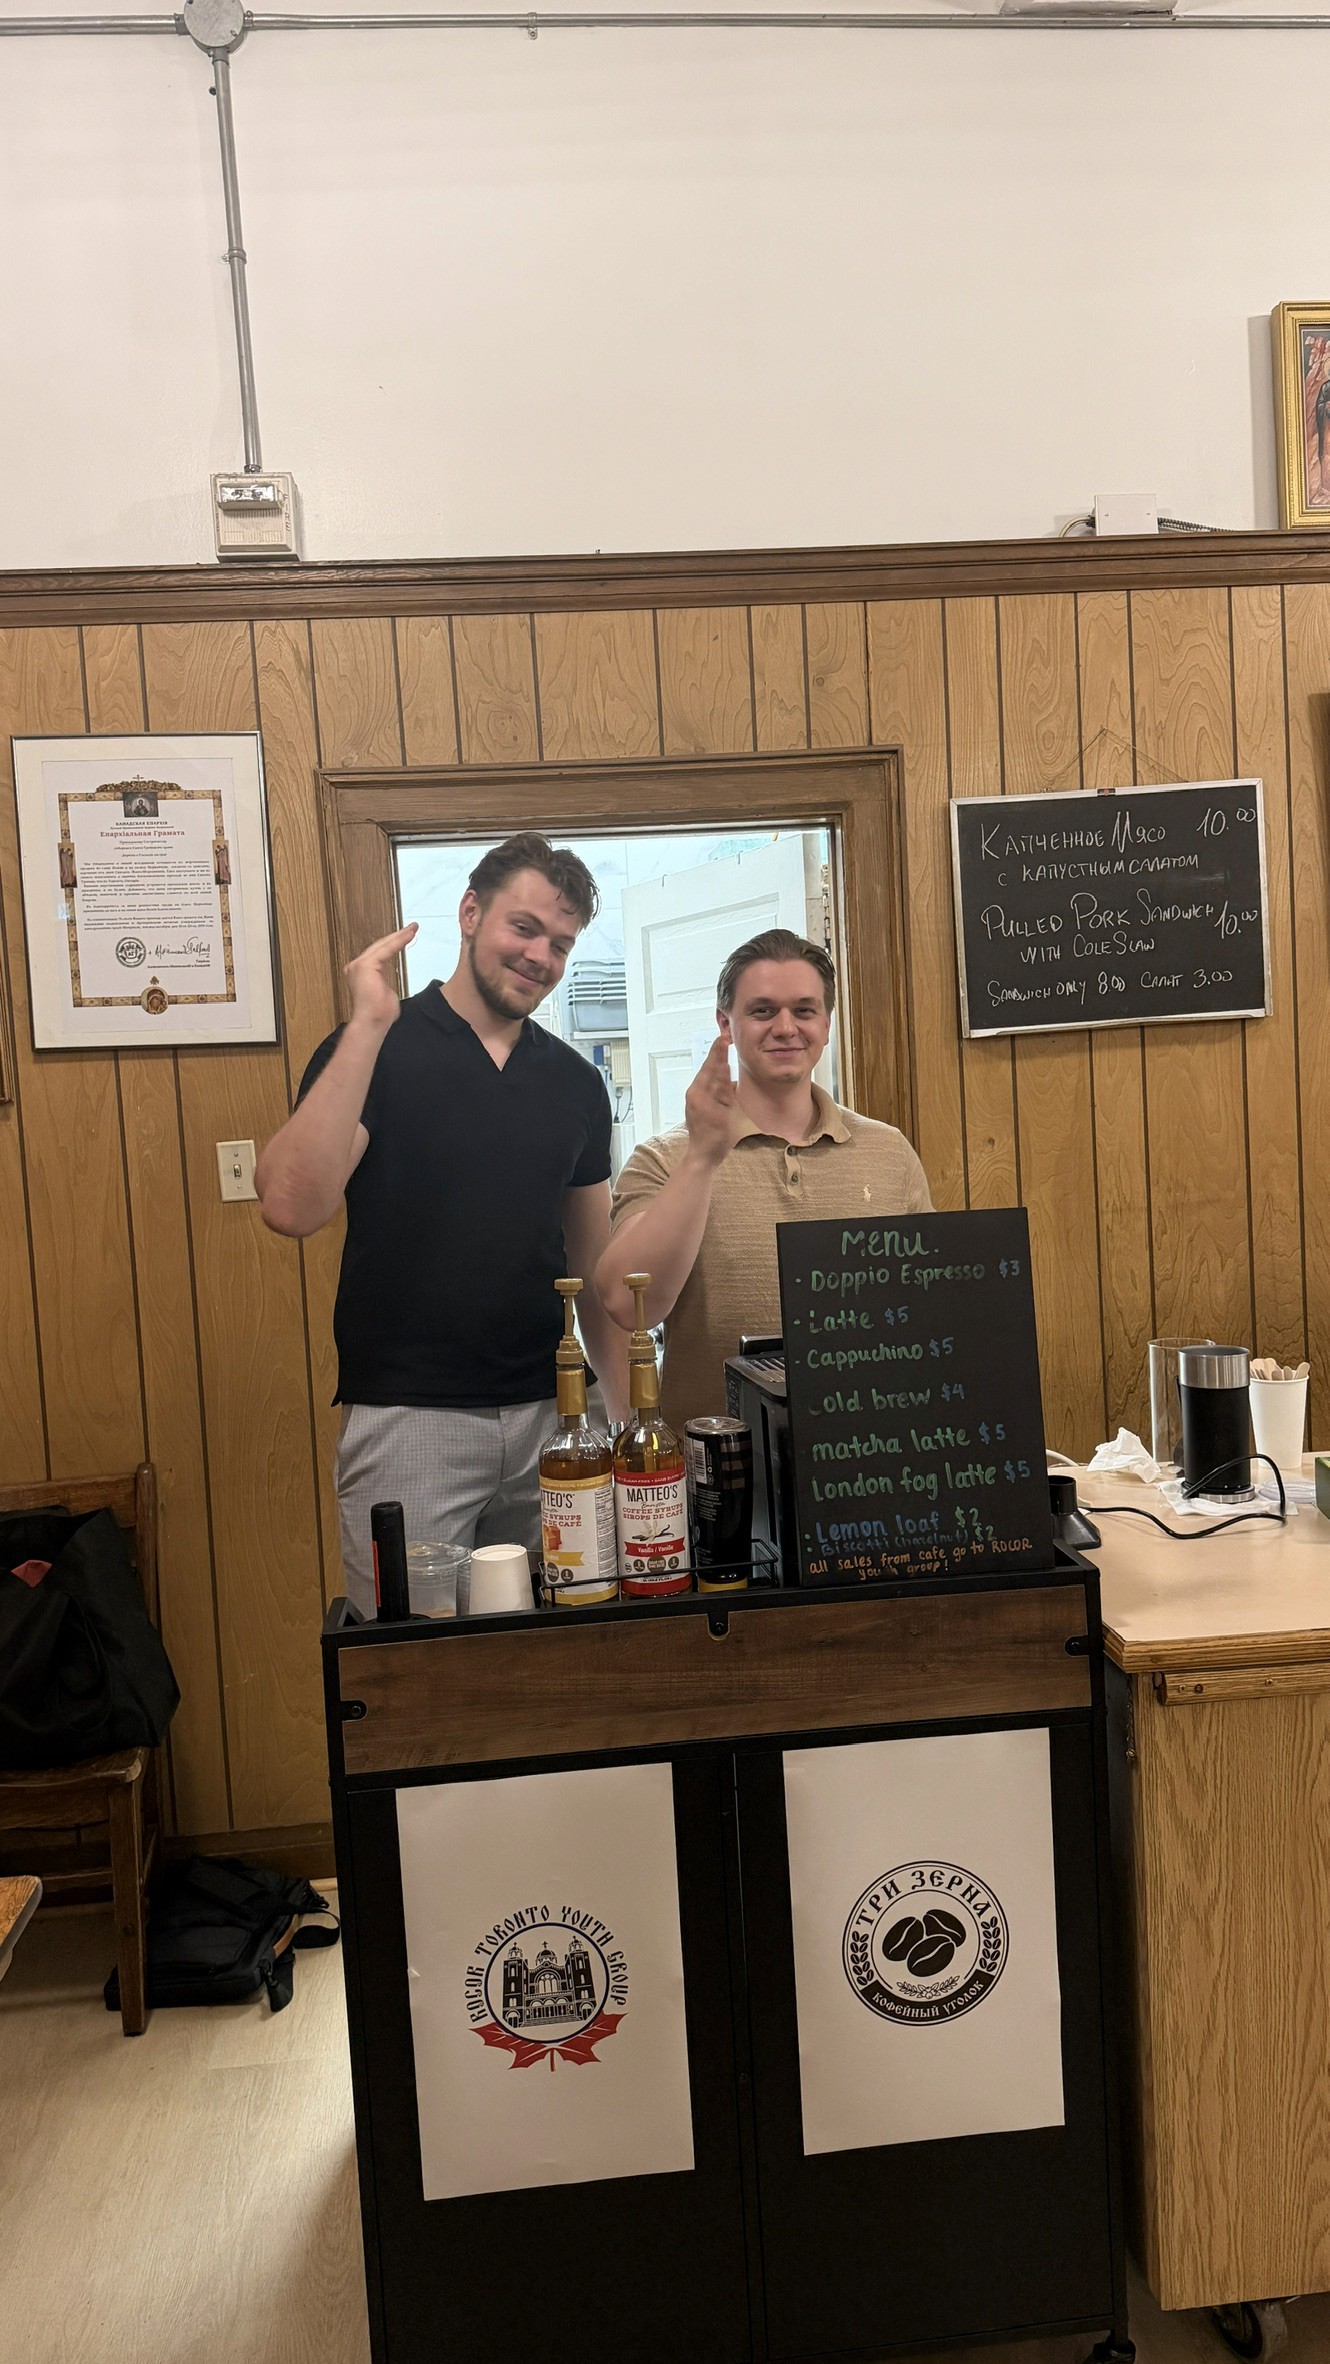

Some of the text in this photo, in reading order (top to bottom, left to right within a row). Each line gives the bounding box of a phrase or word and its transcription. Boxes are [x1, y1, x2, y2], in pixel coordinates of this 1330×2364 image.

[153, 830, 185, 838] Грамата
[1070, 892, 1130, 930] PORK
[1020, 944, 1061, 964] WITH
[1098, 971, 1125, 995] 8.00
[1193, 969, 1233, 988] 3.00
[811, 1258, 1020, 1298] Doppio Espresso $3
[809, 1306, 909, 1334] Latte $5
[806, 1336, 954, 1371] Cappuchino $5
[871, 1388, 931, 1410] brew
[941, 1382, 965, 1401] $4
[812, 1433, 903, 1462] matcha
[910, 1427, 971, 1452] latte
[626, 1484, 678, 1502] MATTEO'S
[900, 1466, 938, 1500] fog
[945, 1462, 997, 1489] latte
[654, 1503, 683, 1513] SYRUPS
[815, 1518, 888, 1544] Lemon
[895, 1511, 940, 1536] loaf
[810, 1560, 828, 1574] all
[838, 1555, 872, 1570] sales
[880, 1552, 911, 1568] from
[952, 1547, 967, 1562] go
[970, 1540, 985, 1554] to
[856, 1878, 902, 1926] ТРИ
[464, 1904, 629, 2023] ROCOR TORONTO YOUTH GROUP
